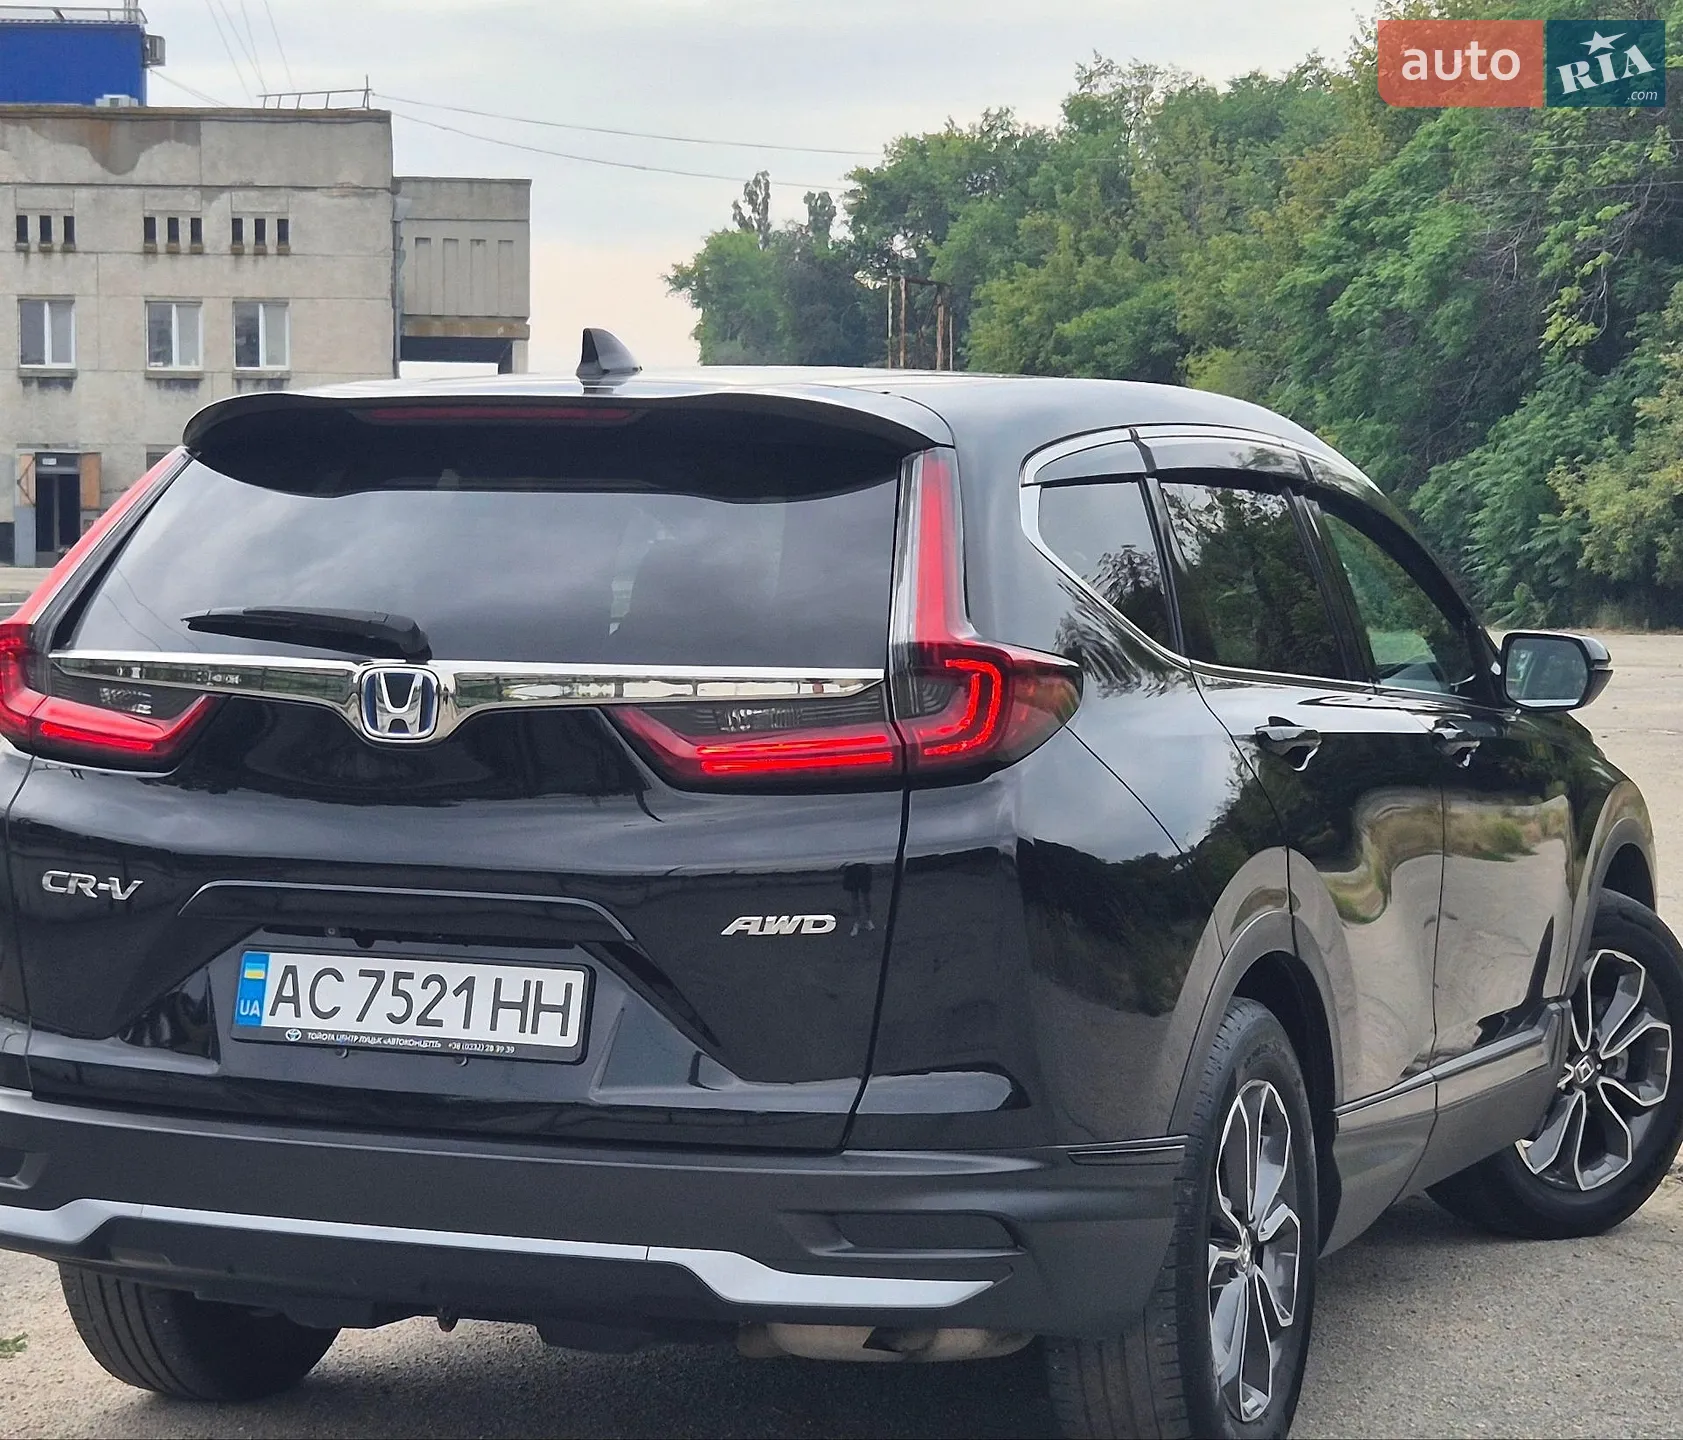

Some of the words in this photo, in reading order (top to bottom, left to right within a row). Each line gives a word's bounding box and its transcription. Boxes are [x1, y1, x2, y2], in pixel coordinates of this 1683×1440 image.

[42, 870, 144, 900] CR-V
[721, 914, 836, 935] AWD
[239, 999, 260, 1018] UA
[269, 965, 344, 1020] AC
[356, 968, 476, 1030] 7521
[490, 977, 573, 1037] HH
